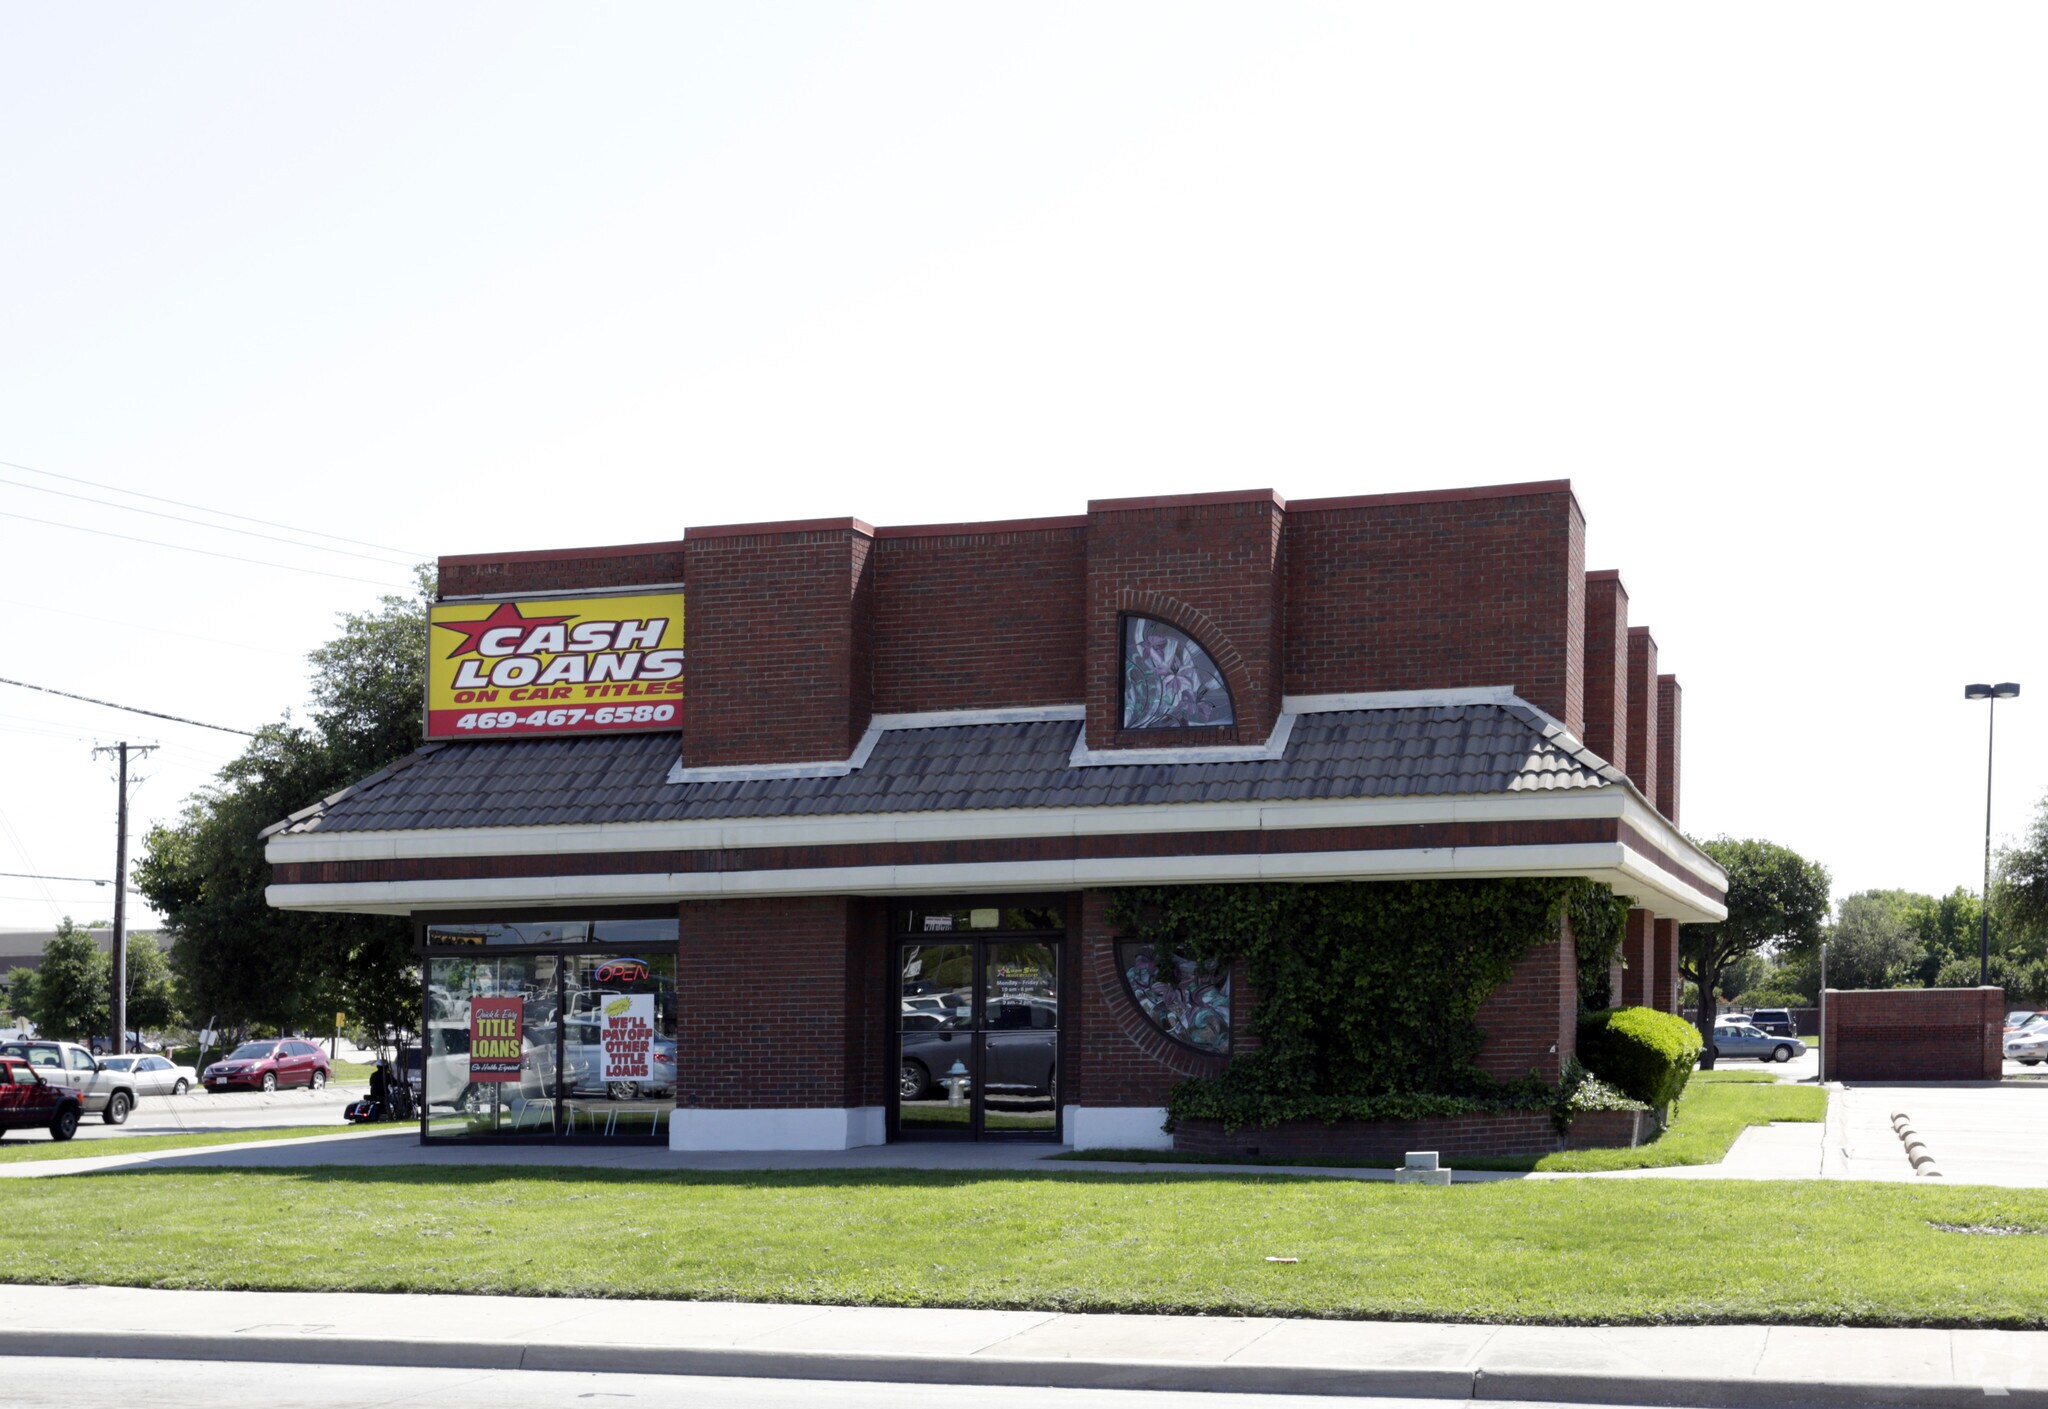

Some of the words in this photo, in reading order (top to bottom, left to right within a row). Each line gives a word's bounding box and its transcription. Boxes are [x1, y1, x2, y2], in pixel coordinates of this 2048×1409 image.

[477, 618, 669, 657] CASH
[451, 649, 684, 690] LOANS
[454, 690, 499, 703] ON
[509, 687, 573, 701] CAR
[584, 681, 684, 698] TITLES
[456, 704, 675, 729] 469-467-6580
[598, 965, 649, 982] OPEN
[475, 1008, 494, 1020] Quick
[501, 1008, 518, 1021] Easy
[608, 1016, 647, 1029] WE'LL
[477, 1018, 516, 1037] TITLE
[472, 1039, 520, 1058] LOANS
[605, 1041, 649, 1053] OTHER
[609, 1053, 646, 1065] TITLE
[605, 1065, 649, 1077] LOANS
